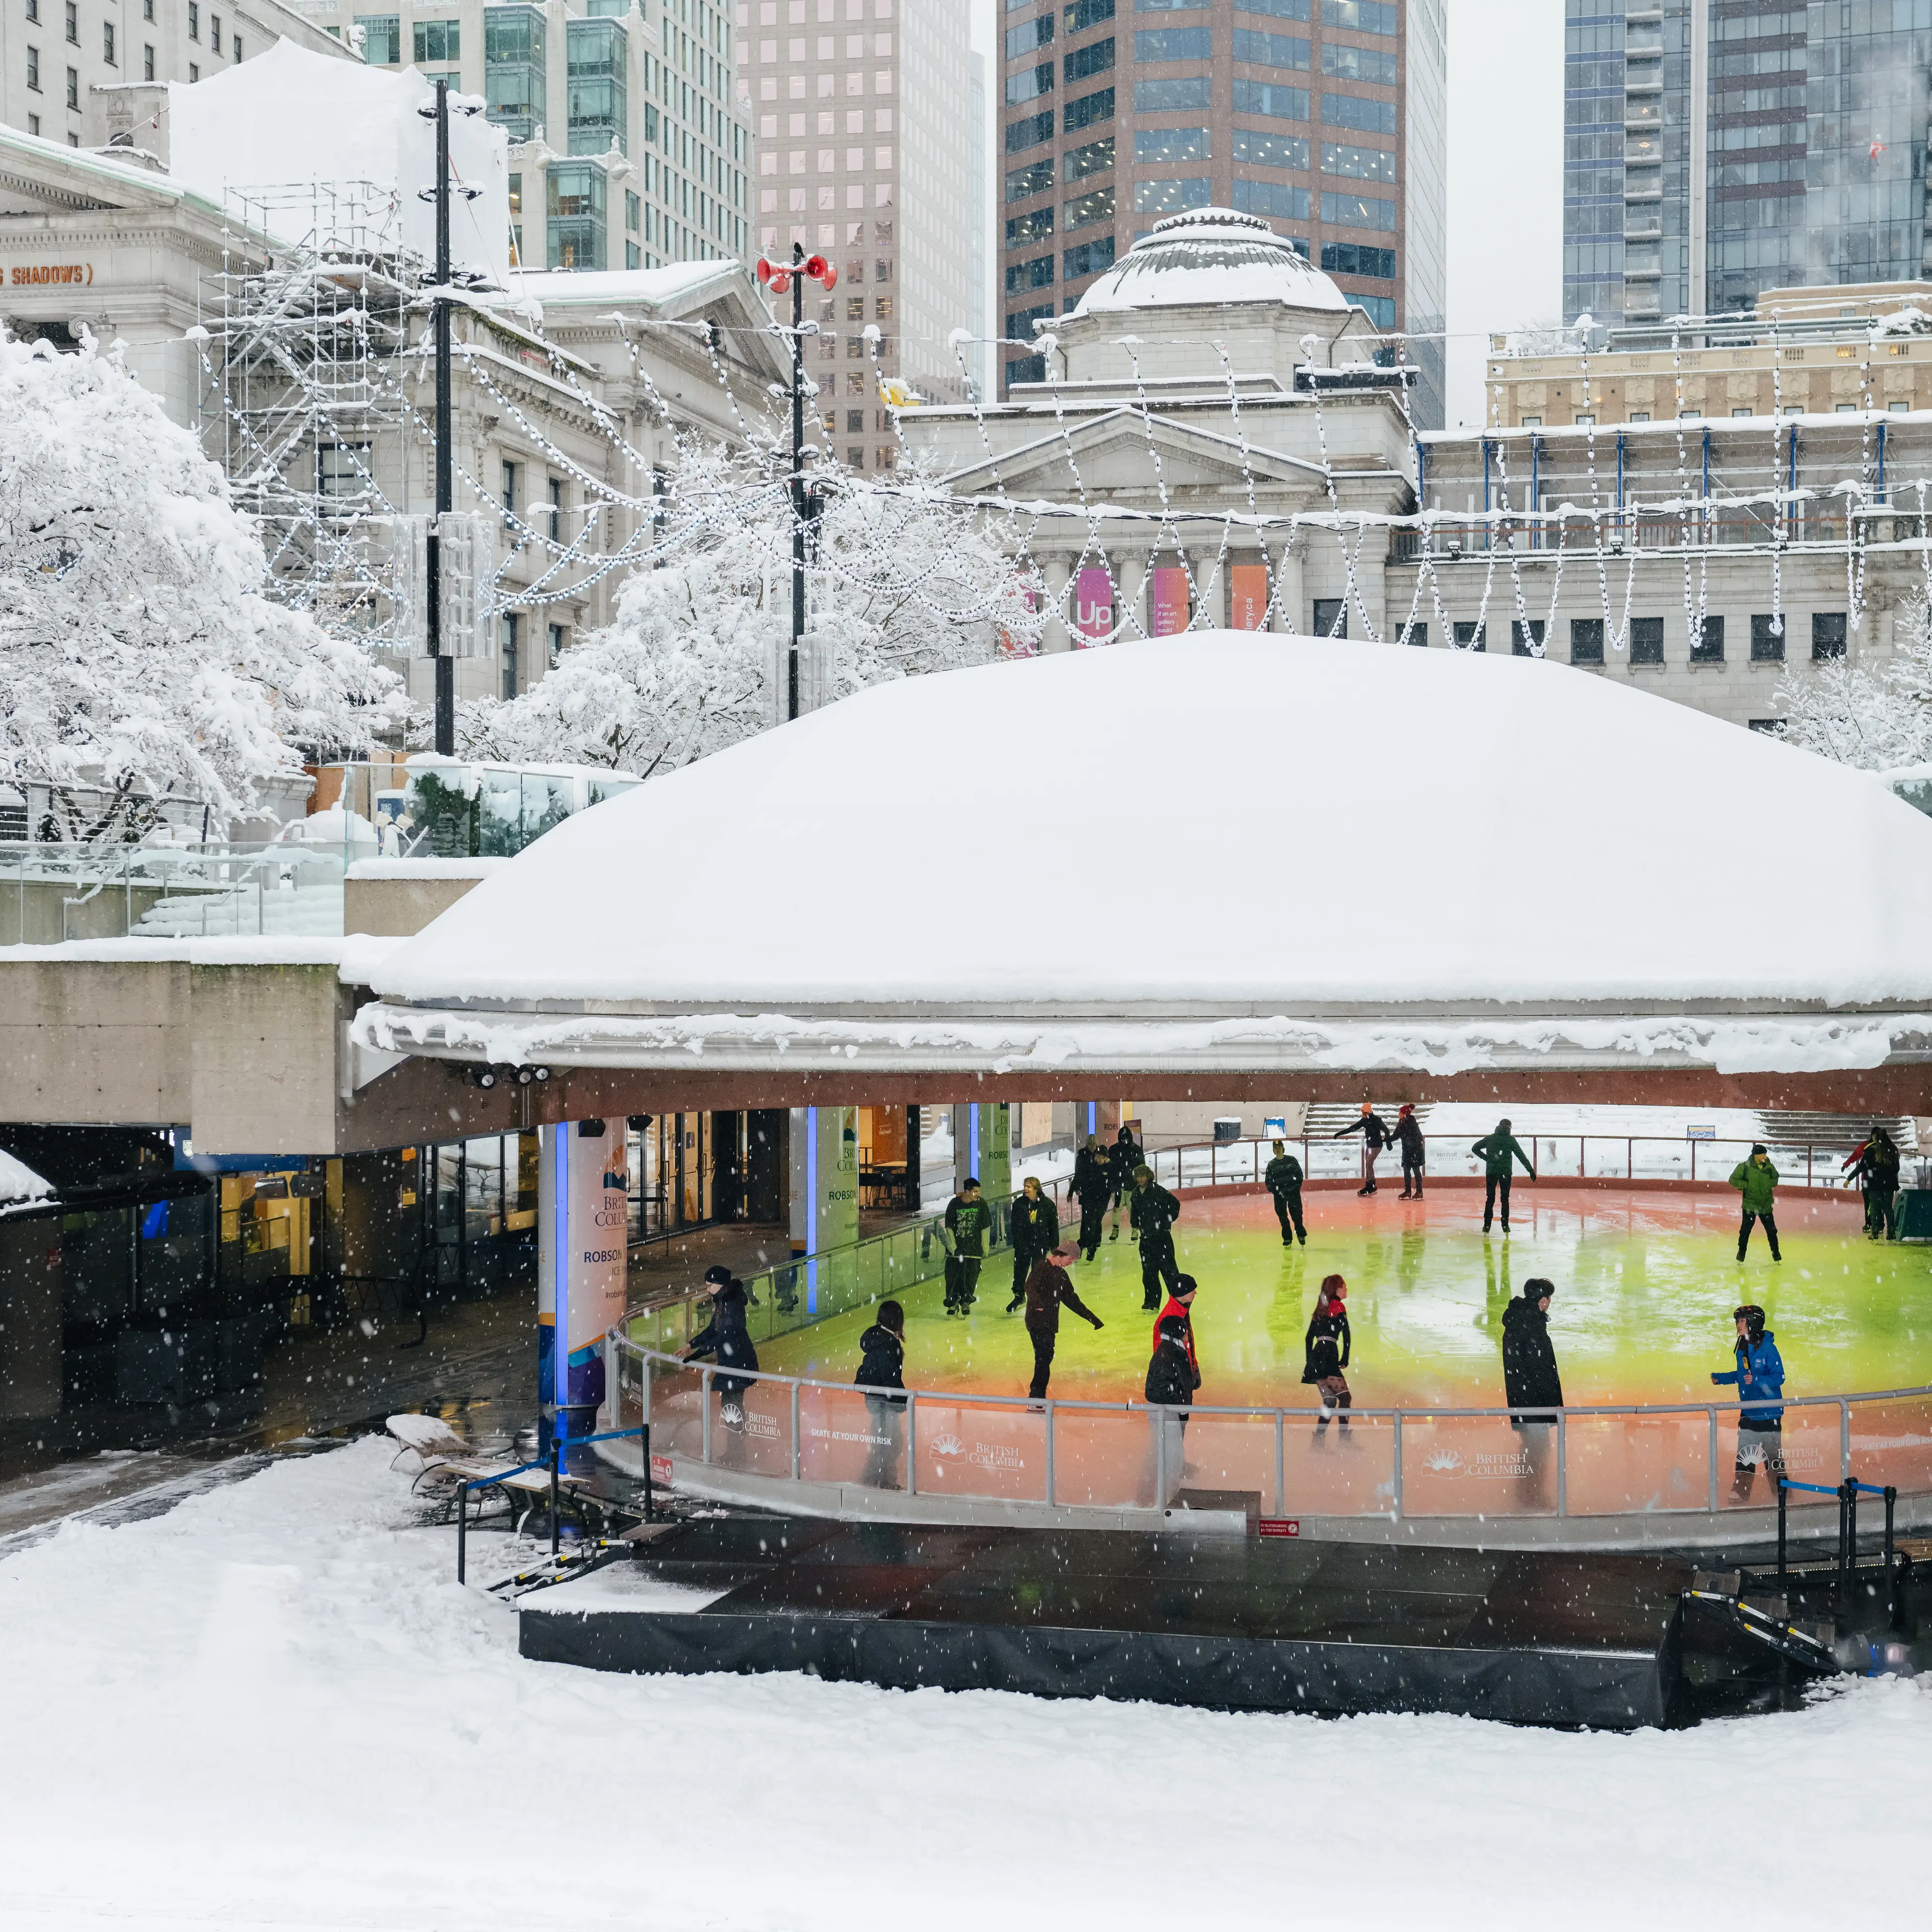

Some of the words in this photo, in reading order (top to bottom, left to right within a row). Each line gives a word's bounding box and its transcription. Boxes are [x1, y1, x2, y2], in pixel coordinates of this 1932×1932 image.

[1077, 601, 1111, 629] Up
[584, 1250, 621, 1262] ROBSON
[612, 1266, 620, 1276] ICE
[749, 1412, 777, 1425] BRITISH
[745, 1421, 781, 1436] COLUMBIA
[811, 1429, 830, 1438] SKATE
[841, 1432, 858, 1441] YOUR
[860, 1435, 875, 1443] OWN
[877, 1437, 892, 1445] RISK
[976, 1443, 1019, 1456] BRITISH
[1861, 1443, 1879, 1451] SKATE
[1888, 1439, 1905, 1447] YOUR
[1906, 1438, 1920, 1446] OWN
[1476, 1454, 1527, 1464] BRITISH
[1778, 1448, 1818, 1459] BRITISH
[969, 1453, 1025, 1468] COLUMBIA
[1771, 1458, 1824, 1470] COLUMBIA
[1468, 1465, 1534, 1475] COLUMBIA
